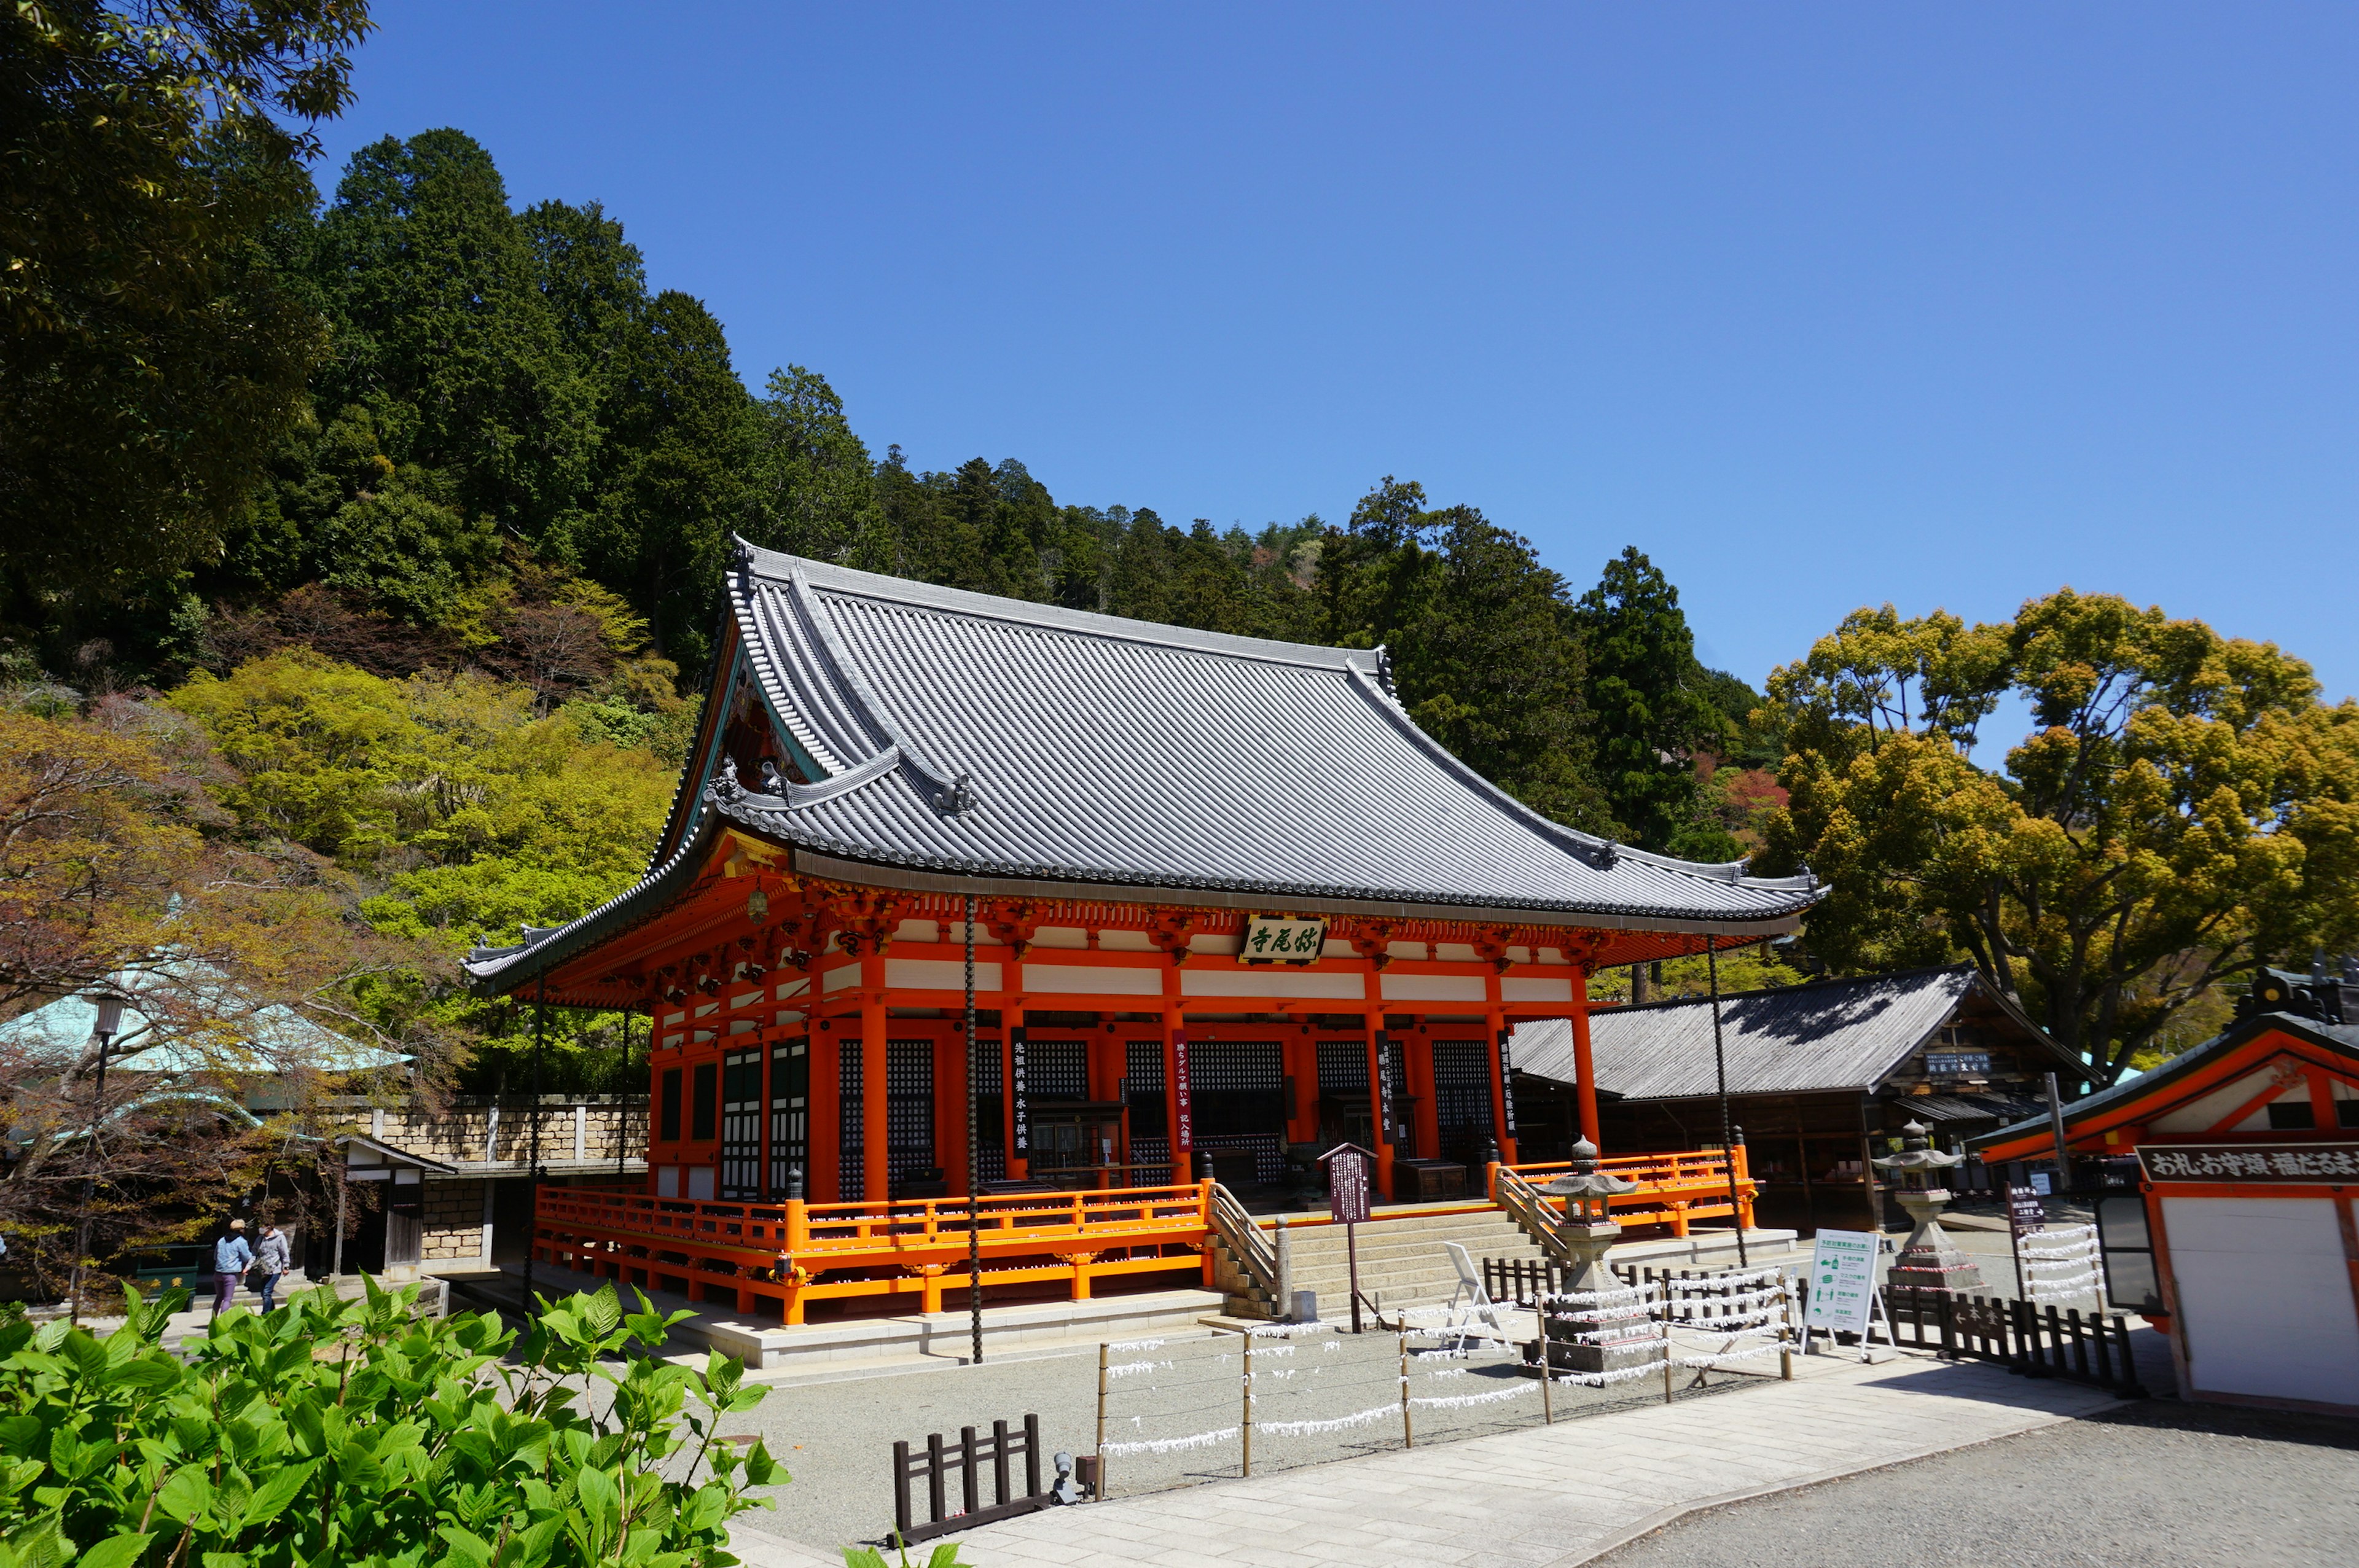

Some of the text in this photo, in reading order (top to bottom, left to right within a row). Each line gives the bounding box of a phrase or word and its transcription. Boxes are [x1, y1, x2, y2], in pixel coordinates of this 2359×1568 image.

[1014, 1042, 1028, 1149] 先祖供養・水子供養
[1176, 1043, 1190, 1146] 勝ちダルマ願い事 記入場所
[2151, 1151, 2359, 1176] お札・お守類・福だるま
[1970, 1306, 1998, 1325] 本堂
